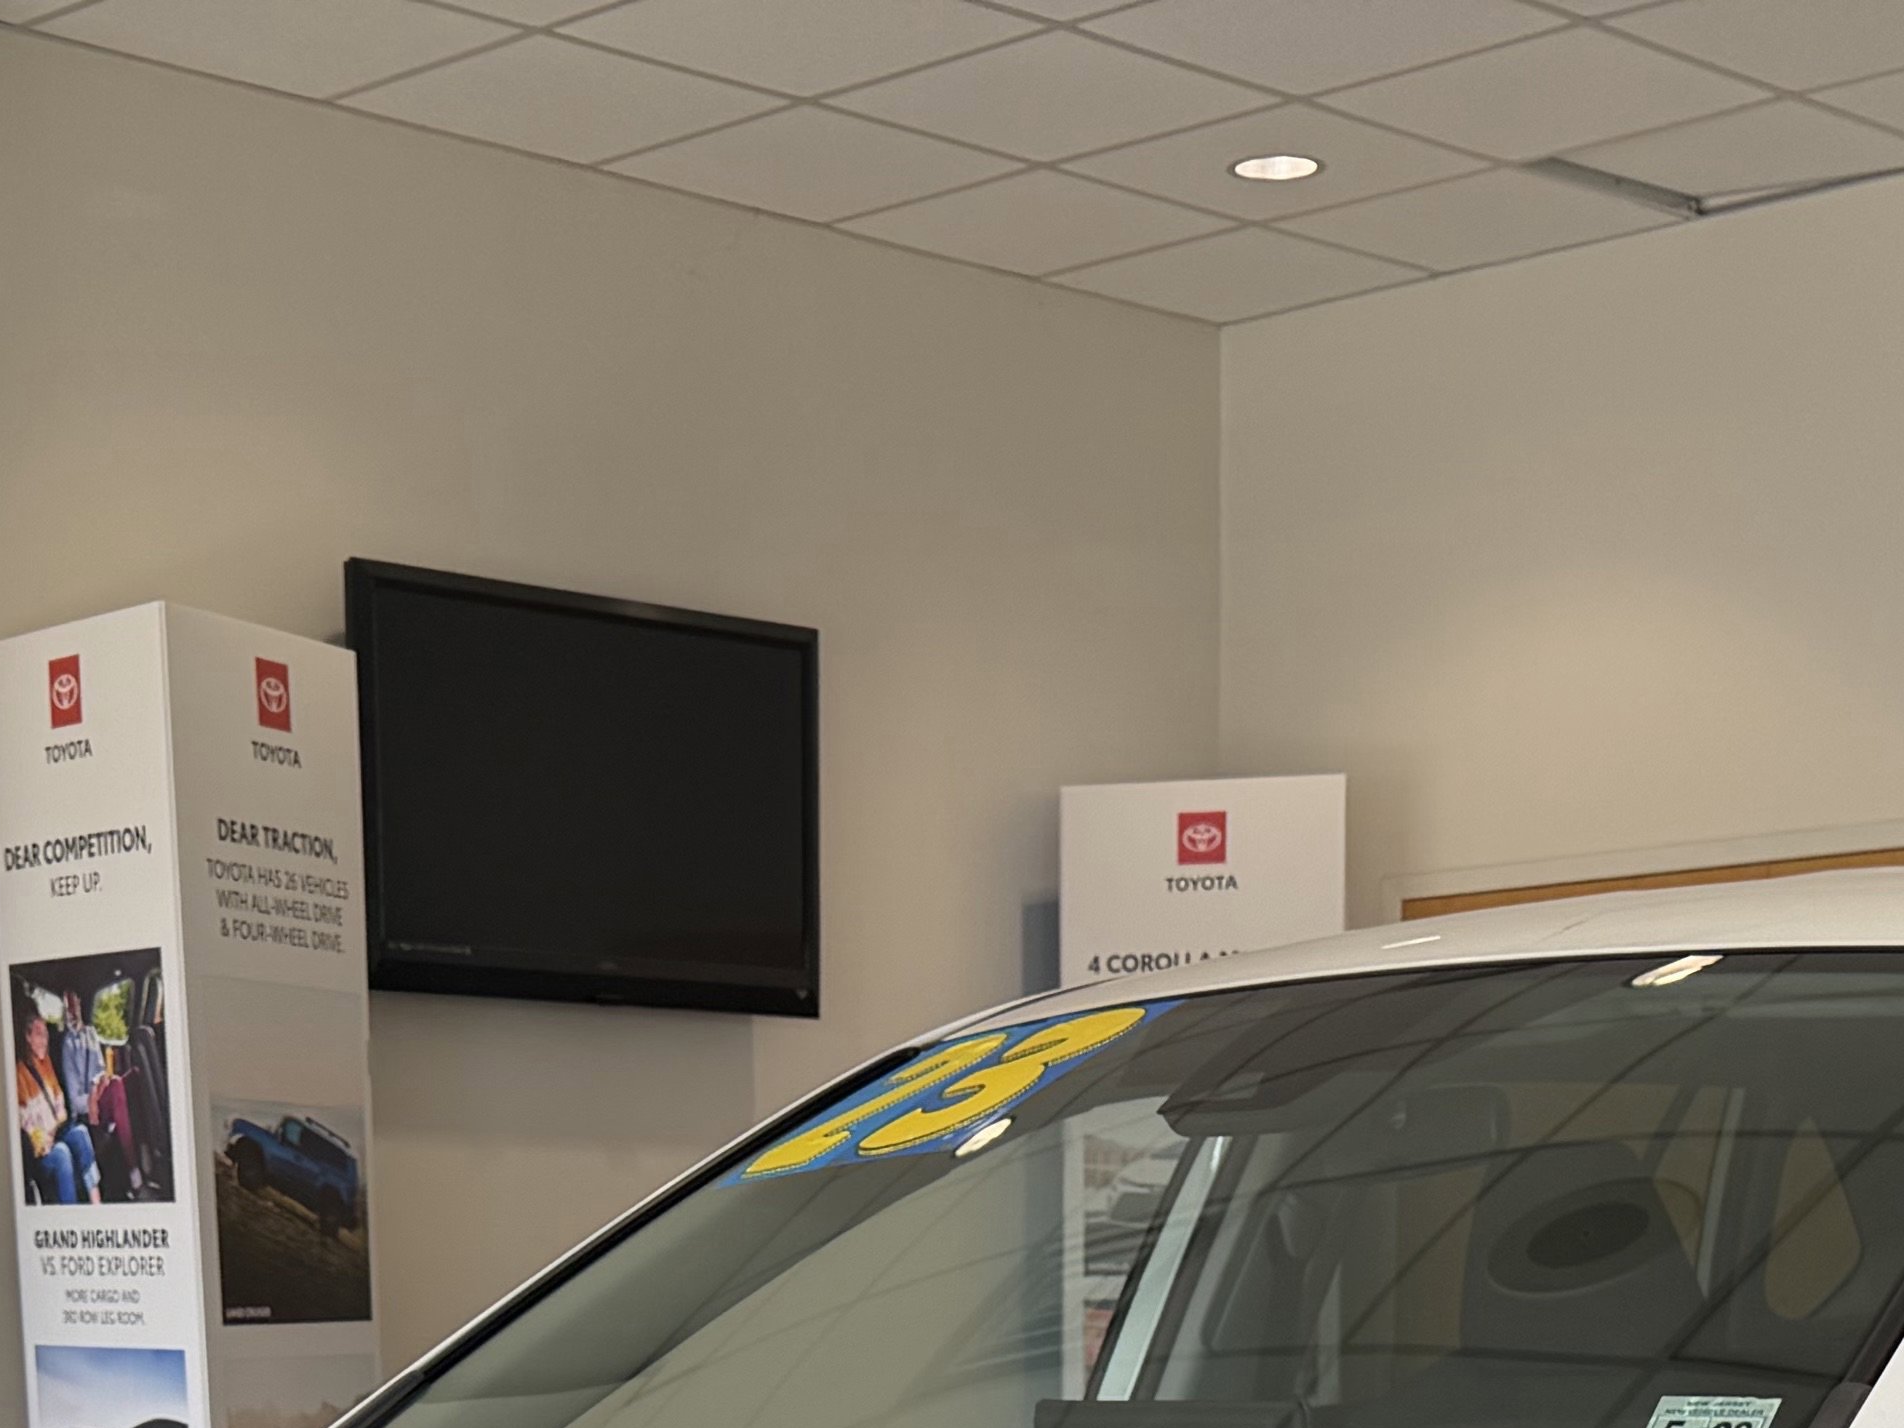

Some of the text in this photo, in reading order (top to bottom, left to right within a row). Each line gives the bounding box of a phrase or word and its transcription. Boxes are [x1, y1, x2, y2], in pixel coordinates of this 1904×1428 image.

[45, 739, 93, 764] TOYOTA
[251, 740, 302, 769] TOYOTA
[4, 824, 152, 872] DEAR COMPETITION,
[216, 817, 339, 864] DEAR TRACTION,
[49, 874, 80, 898] KEEP
[206, 858, 254, 884] TOYOTA
[257, 866, 282, 889] HAS
[1165, 875, 1239, 893] TOYOTA
[215, 889, 248, 911] WITH
[251, 893, 312, 921] ALL-WHEEL
[232, 918, 310, 949] FOUR-WHEEL
[1087, 955, 1100, 975] 4
[1106, 951, 1209, 974] CORO
[34, 1228, 170, 1249] GRAND HIGHLANDER
[60, 1255, 94, 1276] FORD
[97, 1255, 165, 1276] EXPLORER
